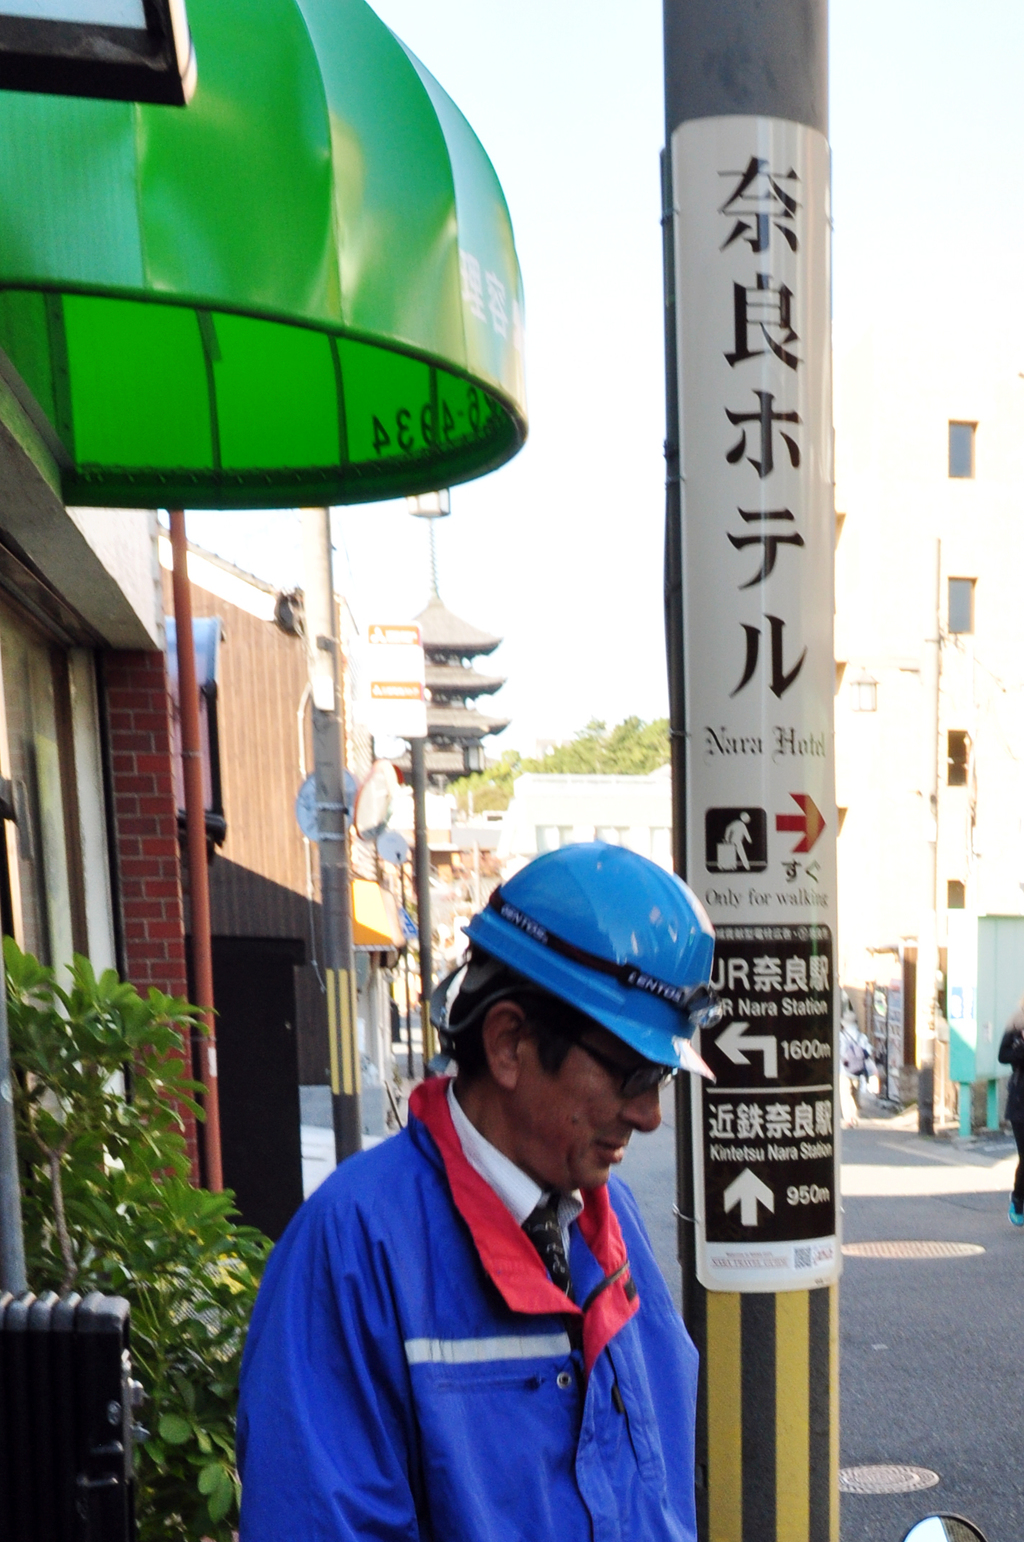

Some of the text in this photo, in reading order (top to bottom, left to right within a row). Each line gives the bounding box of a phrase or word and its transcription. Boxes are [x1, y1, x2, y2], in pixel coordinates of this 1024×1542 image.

[717, 155, 807, 700] 奈良ホテル
[705, 726, 826, 766] Nara Hotel
[781, 859, 821, 882] すぐ
[705, 887, 829, 908] Only for walking
[709, 954, 829, 992] JR奈良駅
[721, 996, 828, 1016] R Nara Station
[781, 1039, 831, 1060] 1600m
[709, 1100, 832, 1139] 近鉄奈良駅
[710, 1141, 832, 1161] Kintetsu Nara Station
[786, 1185, 831, 1206] 950m
